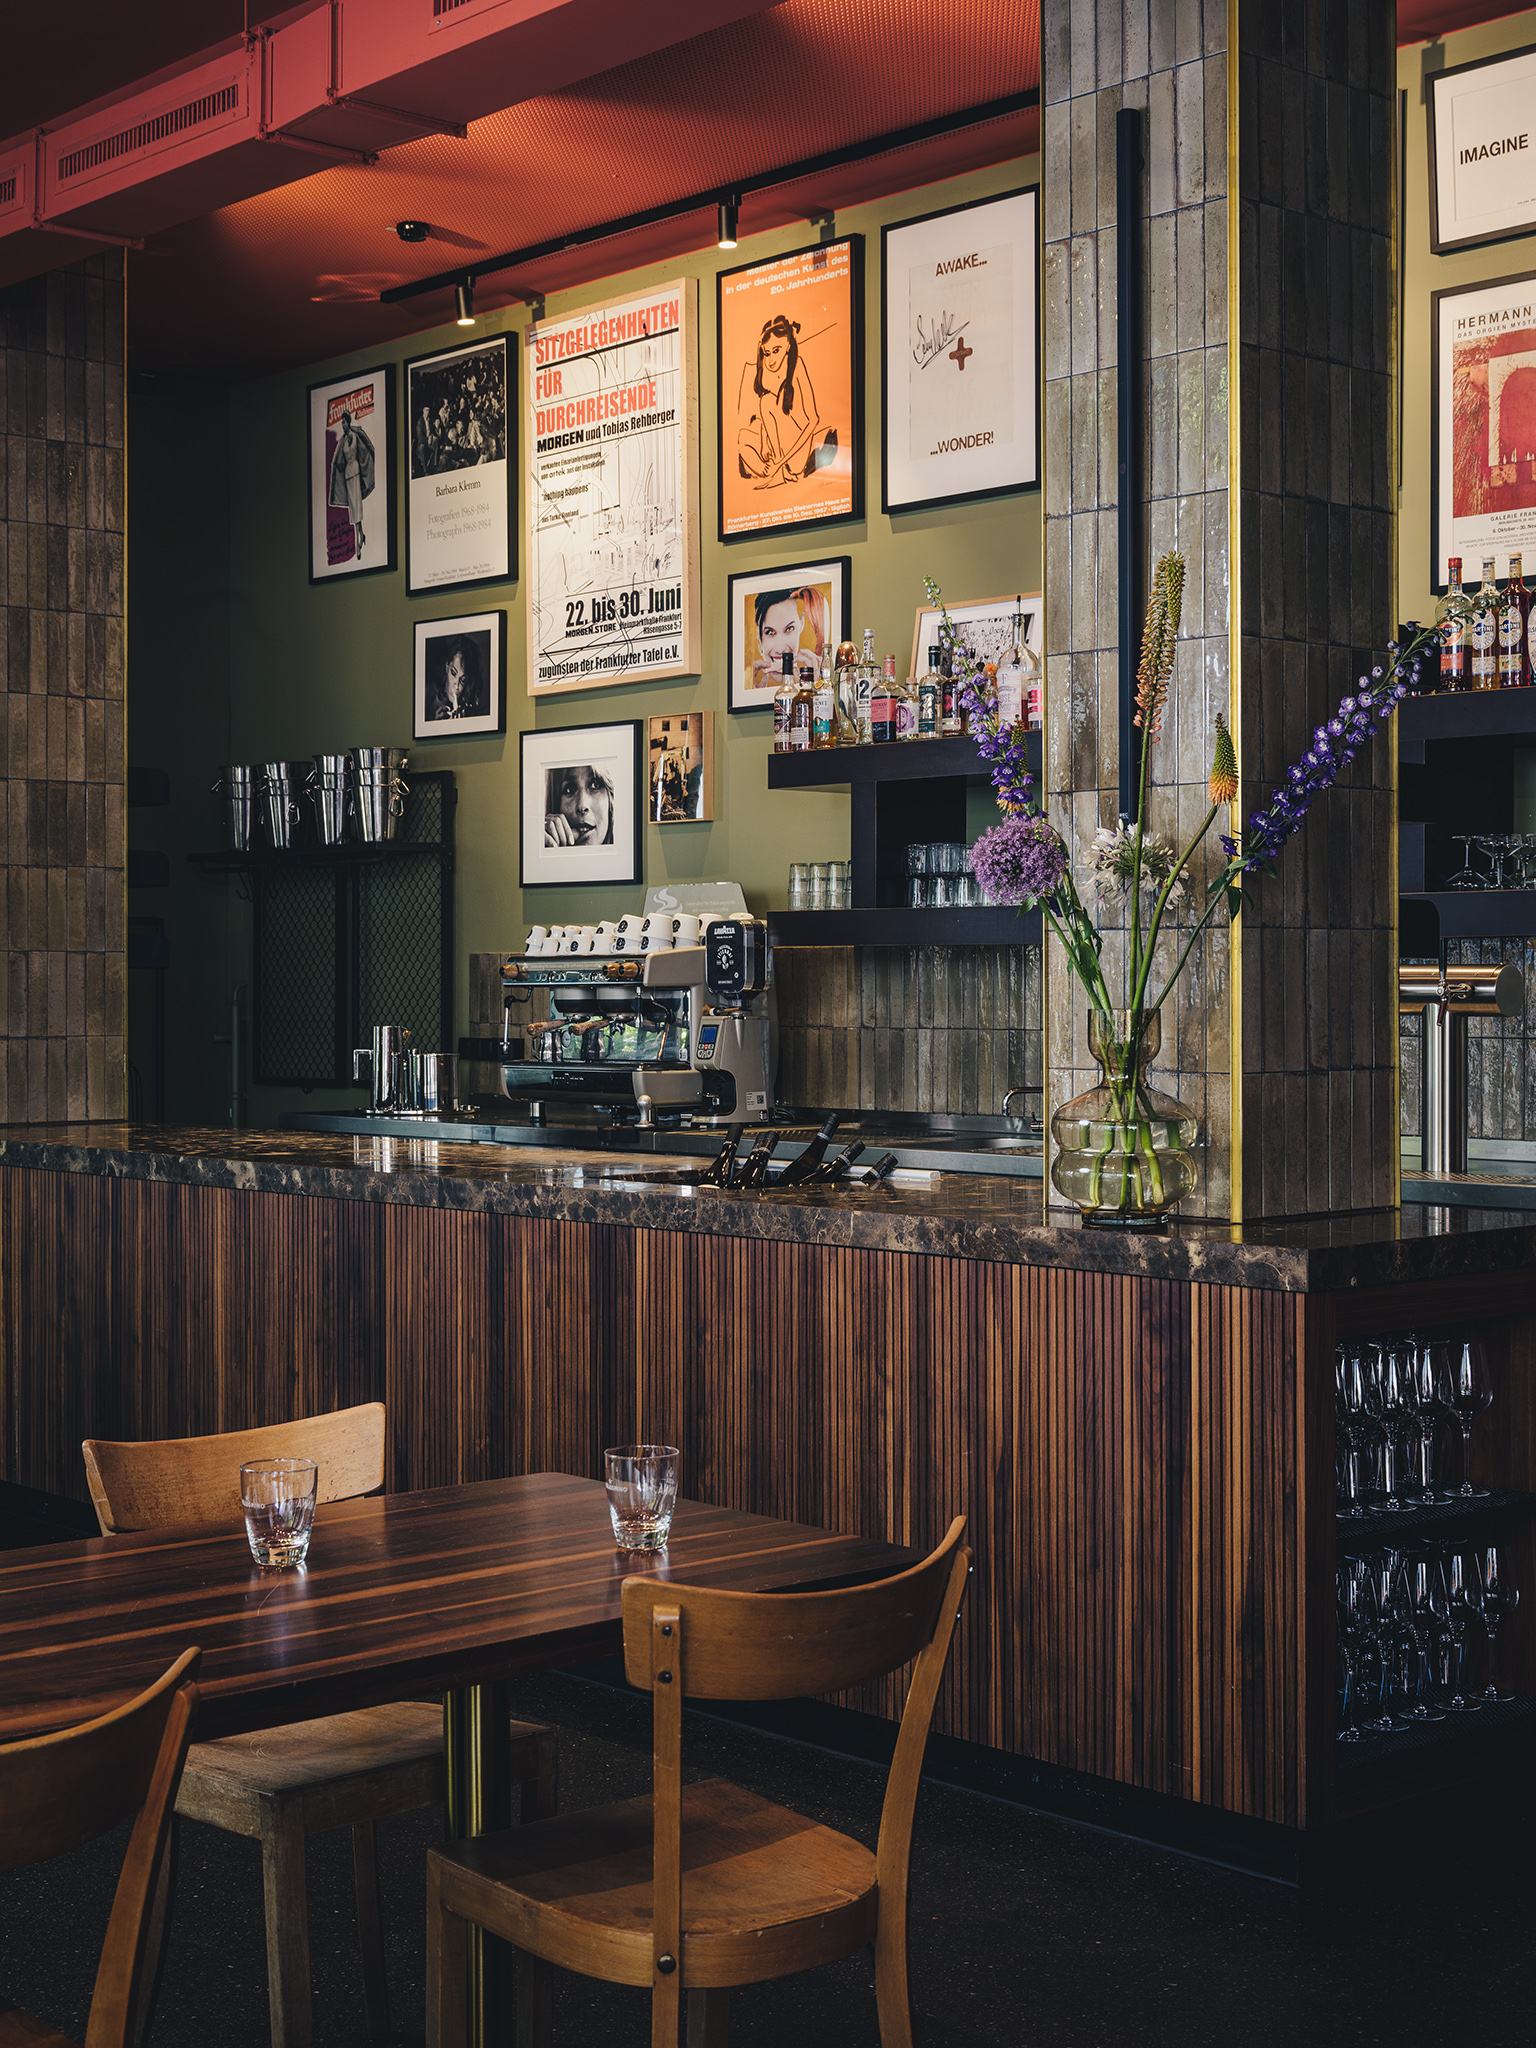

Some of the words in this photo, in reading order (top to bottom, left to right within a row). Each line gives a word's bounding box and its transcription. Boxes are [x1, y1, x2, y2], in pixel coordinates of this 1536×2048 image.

[1460, 133, 1529, 165] IMAGINE
[736, 282, 752, 292] der
[754, 268, 800, 287] deutschen
[802, 259, 829, 273] Kunst
[831, 255, 848, 265] des
[770, 284, 785, 295] 20.
[786, 267, 849, 291] Jahrhunderts
[536, 299, 679, 365] SITZGELEGENHEITEN
[1457, 306, 1532, 330] HERMANN
[1457, 330, 1473, 339] DAS
[1476, 324, 1507, 335] ORGIEN
[536, 369, 562, 400] FÜR
[536, 381, 657, 436] DURCHREISENDE
[537, 429, 584, 453] MORGEN
[585, 425, 601, 441] und
[602, 419, 629, 437] Tobias
[630, 409, 676, 430] Rehberger
[435, 484, 458, 497] Barbara
[459, 480, 481, 493] Klemm
[1491, 513, 1517, 521] GALERIE
[566, 600, 589, 628] 22.
[592, 596, 616, 624] bis
[620, 590, 645, 619] 30.
[648, 583, 681, 614] Juni
[565, 622, 617, 638] MORGEN.STORE
[659, 612, 682, 623] Frankfurt
[539, 661, 579, 679] zugunsten
[580, 658, 594, 672] der
[596, 650, 641, 670] Frankfurter
[643, 647, 664, 662] Tafel
[665, 644, 680, 660] e.V.
